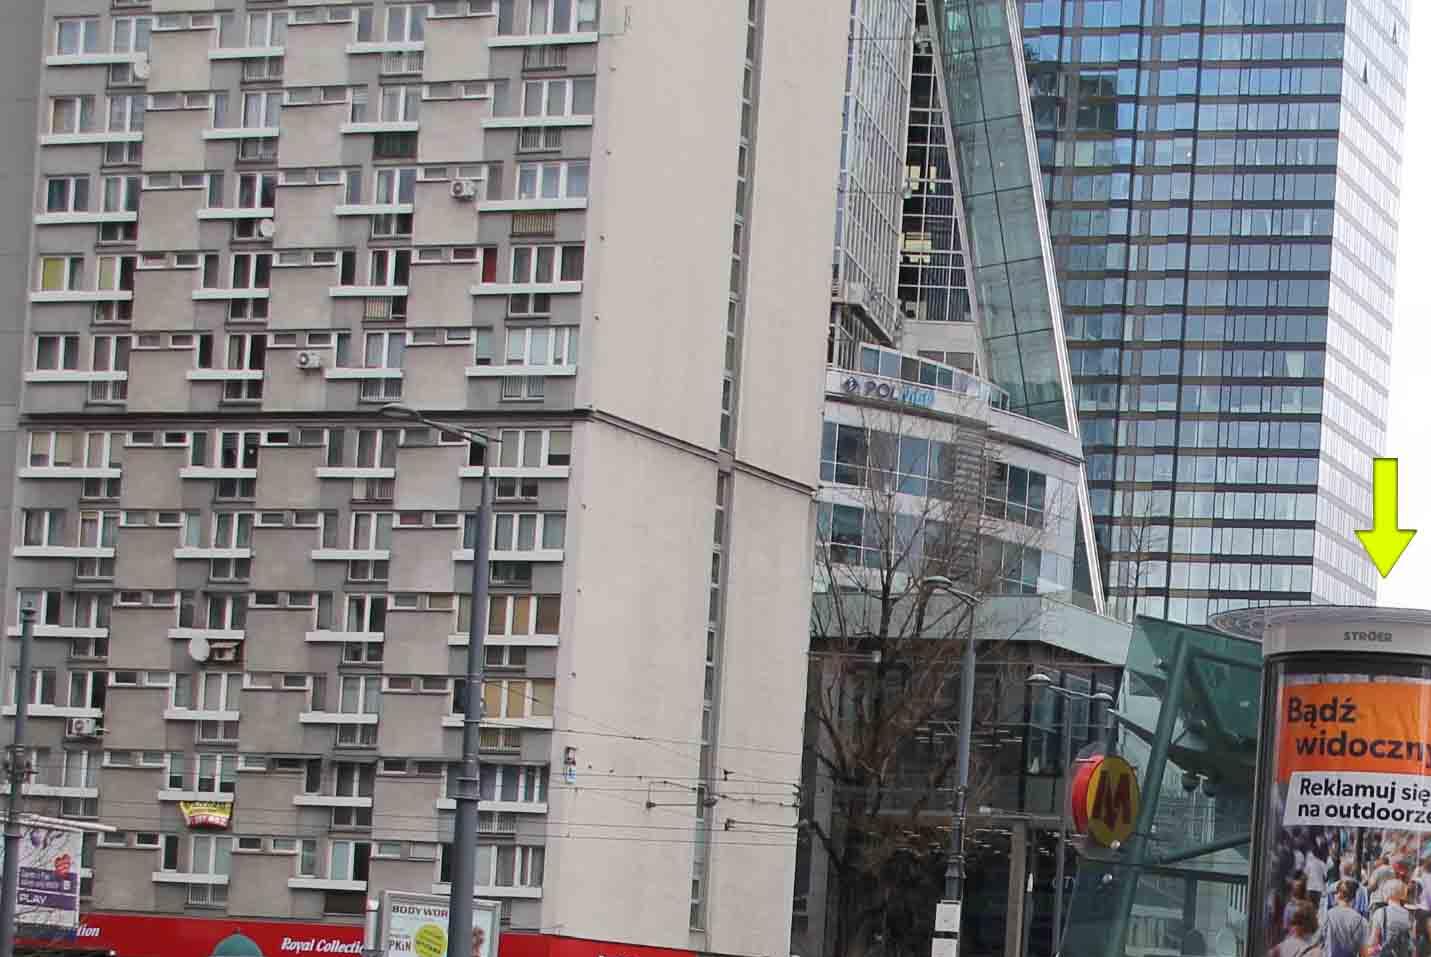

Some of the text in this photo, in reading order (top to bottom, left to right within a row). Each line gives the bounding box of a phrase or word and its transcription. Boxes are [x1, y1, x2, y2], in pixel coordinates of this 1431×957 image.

[1287, 697, 1356, 727] Bądź
[1300, 778, 1431, 806] Reklamuj się
[1297, 804, 1320, 817] na
[281, 937, 315, 955] Royal
